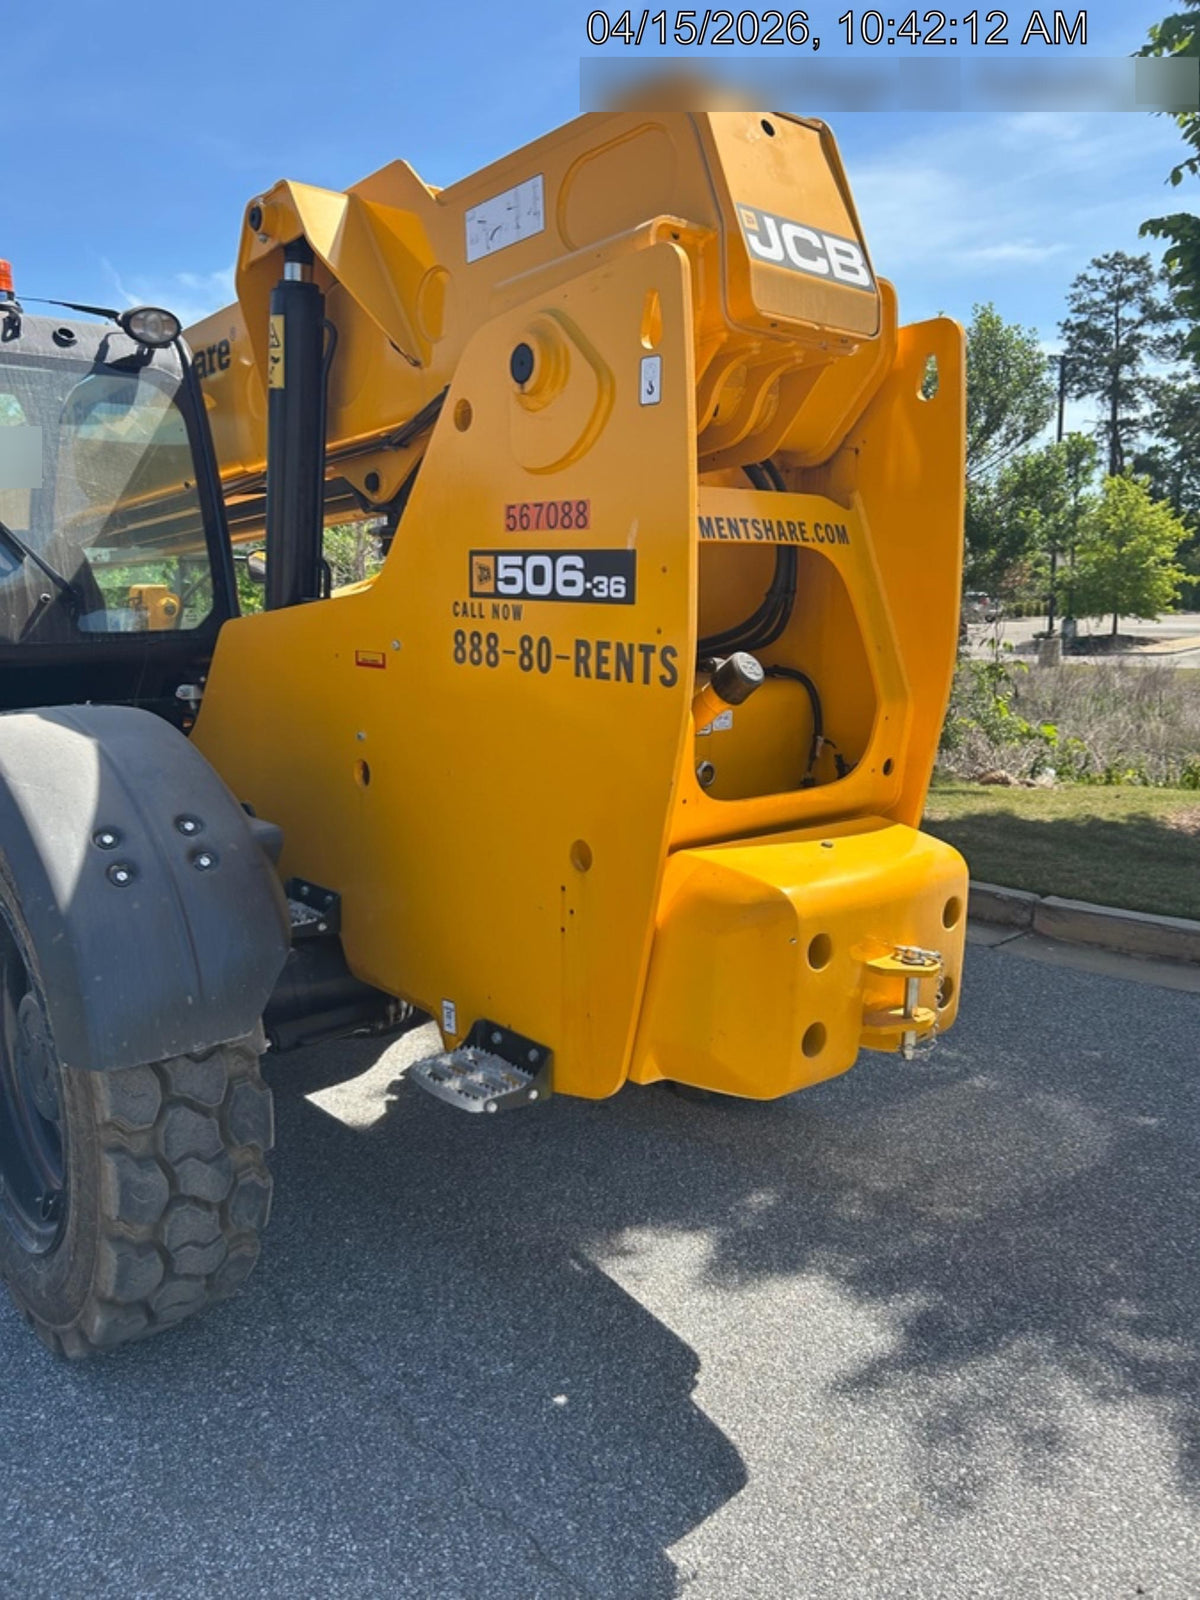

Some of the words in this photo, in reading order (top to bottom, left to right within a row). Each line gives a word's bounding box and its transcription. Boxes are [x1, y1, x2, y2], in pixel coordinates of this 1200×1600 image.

[747, 215, 871, 287] JCB
[506, 500, 588, 531] 567088
[452, 601, 485, 619] CALL
[491, 603, 524, 622] NOW
[453, 629, 679, 688] 888-80-RENTS
